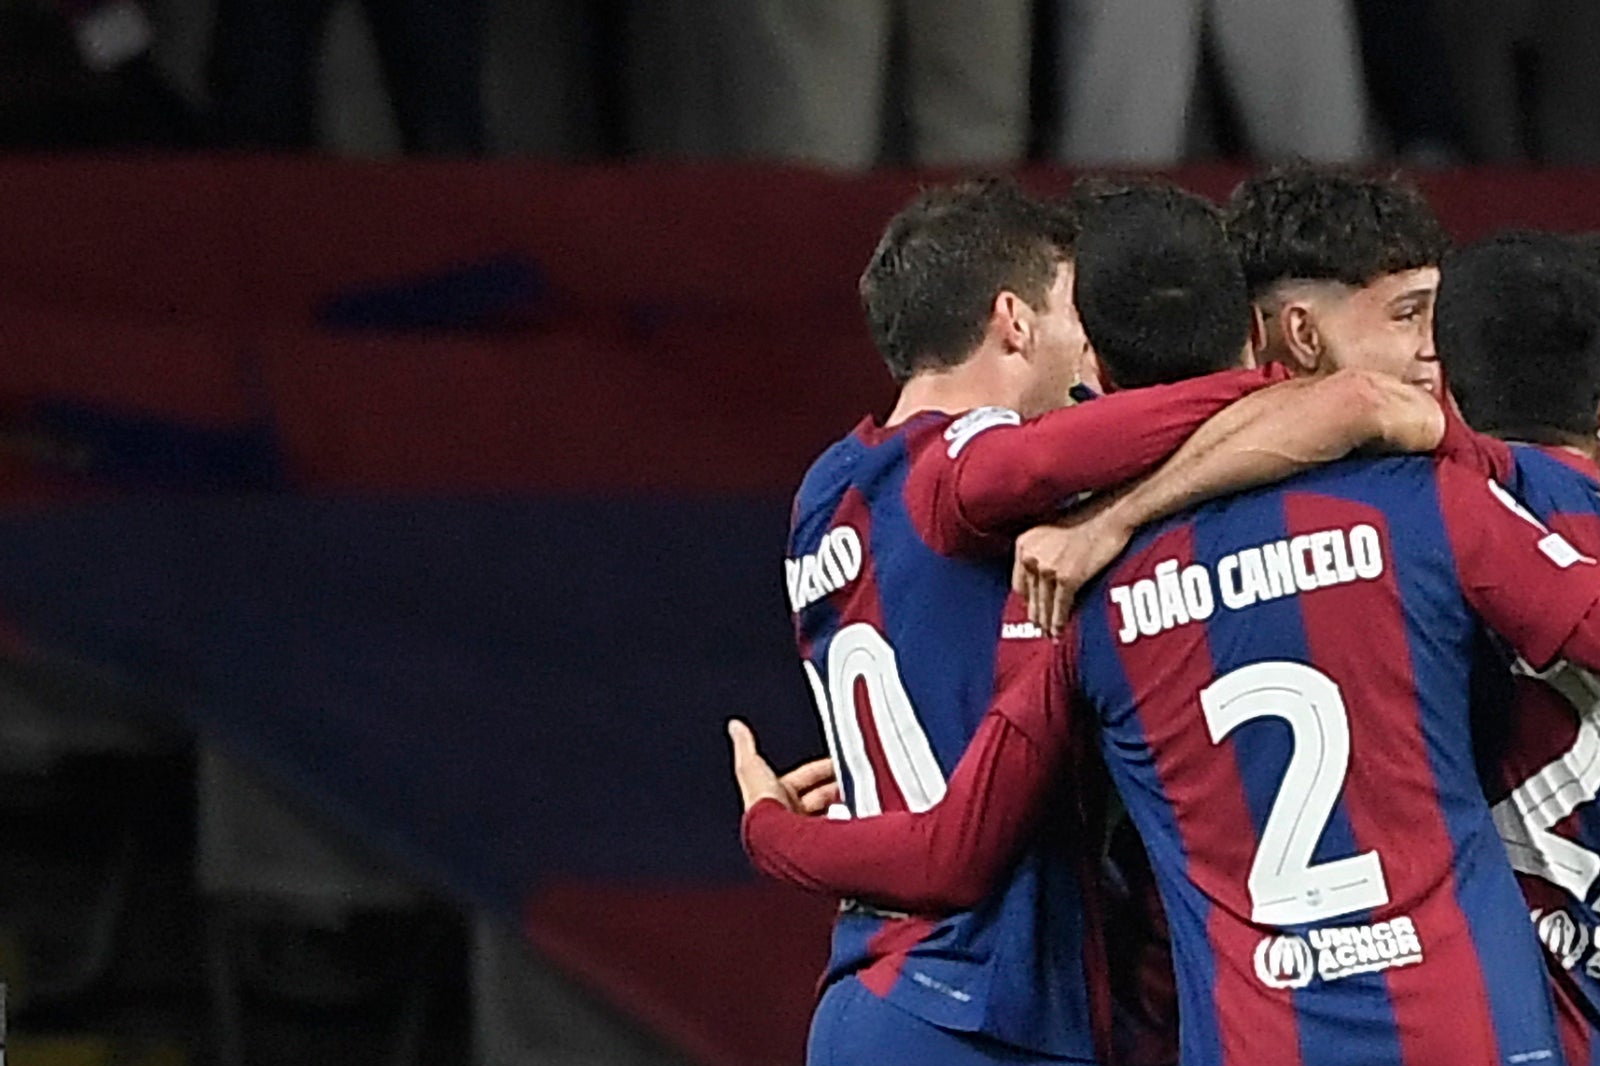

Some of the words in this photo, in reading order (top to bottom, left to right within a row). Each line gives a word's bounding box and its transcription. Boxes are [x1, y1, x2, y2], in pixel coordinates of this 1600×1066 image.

[1110, 557, 1214, 643] JOÃO
[1218, 523, 1385, 610] CANCELO
[1200, 660, 1390, 926] 2
